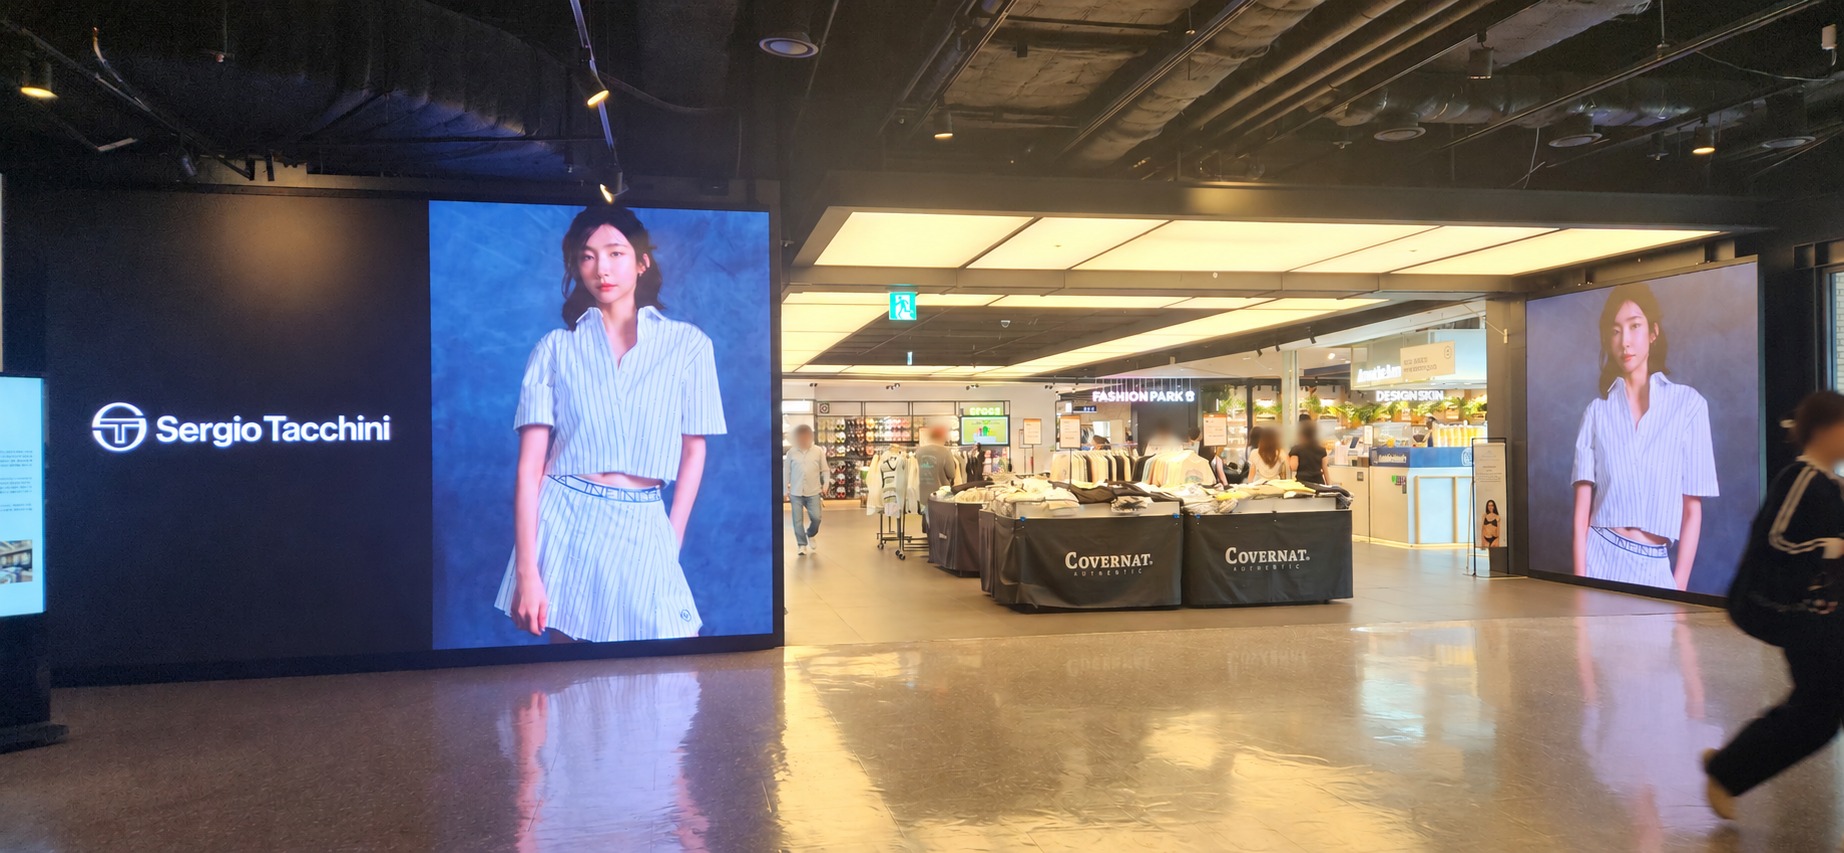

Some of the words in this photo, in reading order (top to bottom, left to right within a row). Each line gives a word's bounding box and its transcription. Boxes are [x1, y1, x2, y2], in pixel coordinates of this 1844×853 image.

[1092, 391, 1149, 402] FASHION
[1150, 391, 1184, 402] PARK
[156, 415, 262, 448] Sergio
[263, 414, 391, 442] Tacchini
